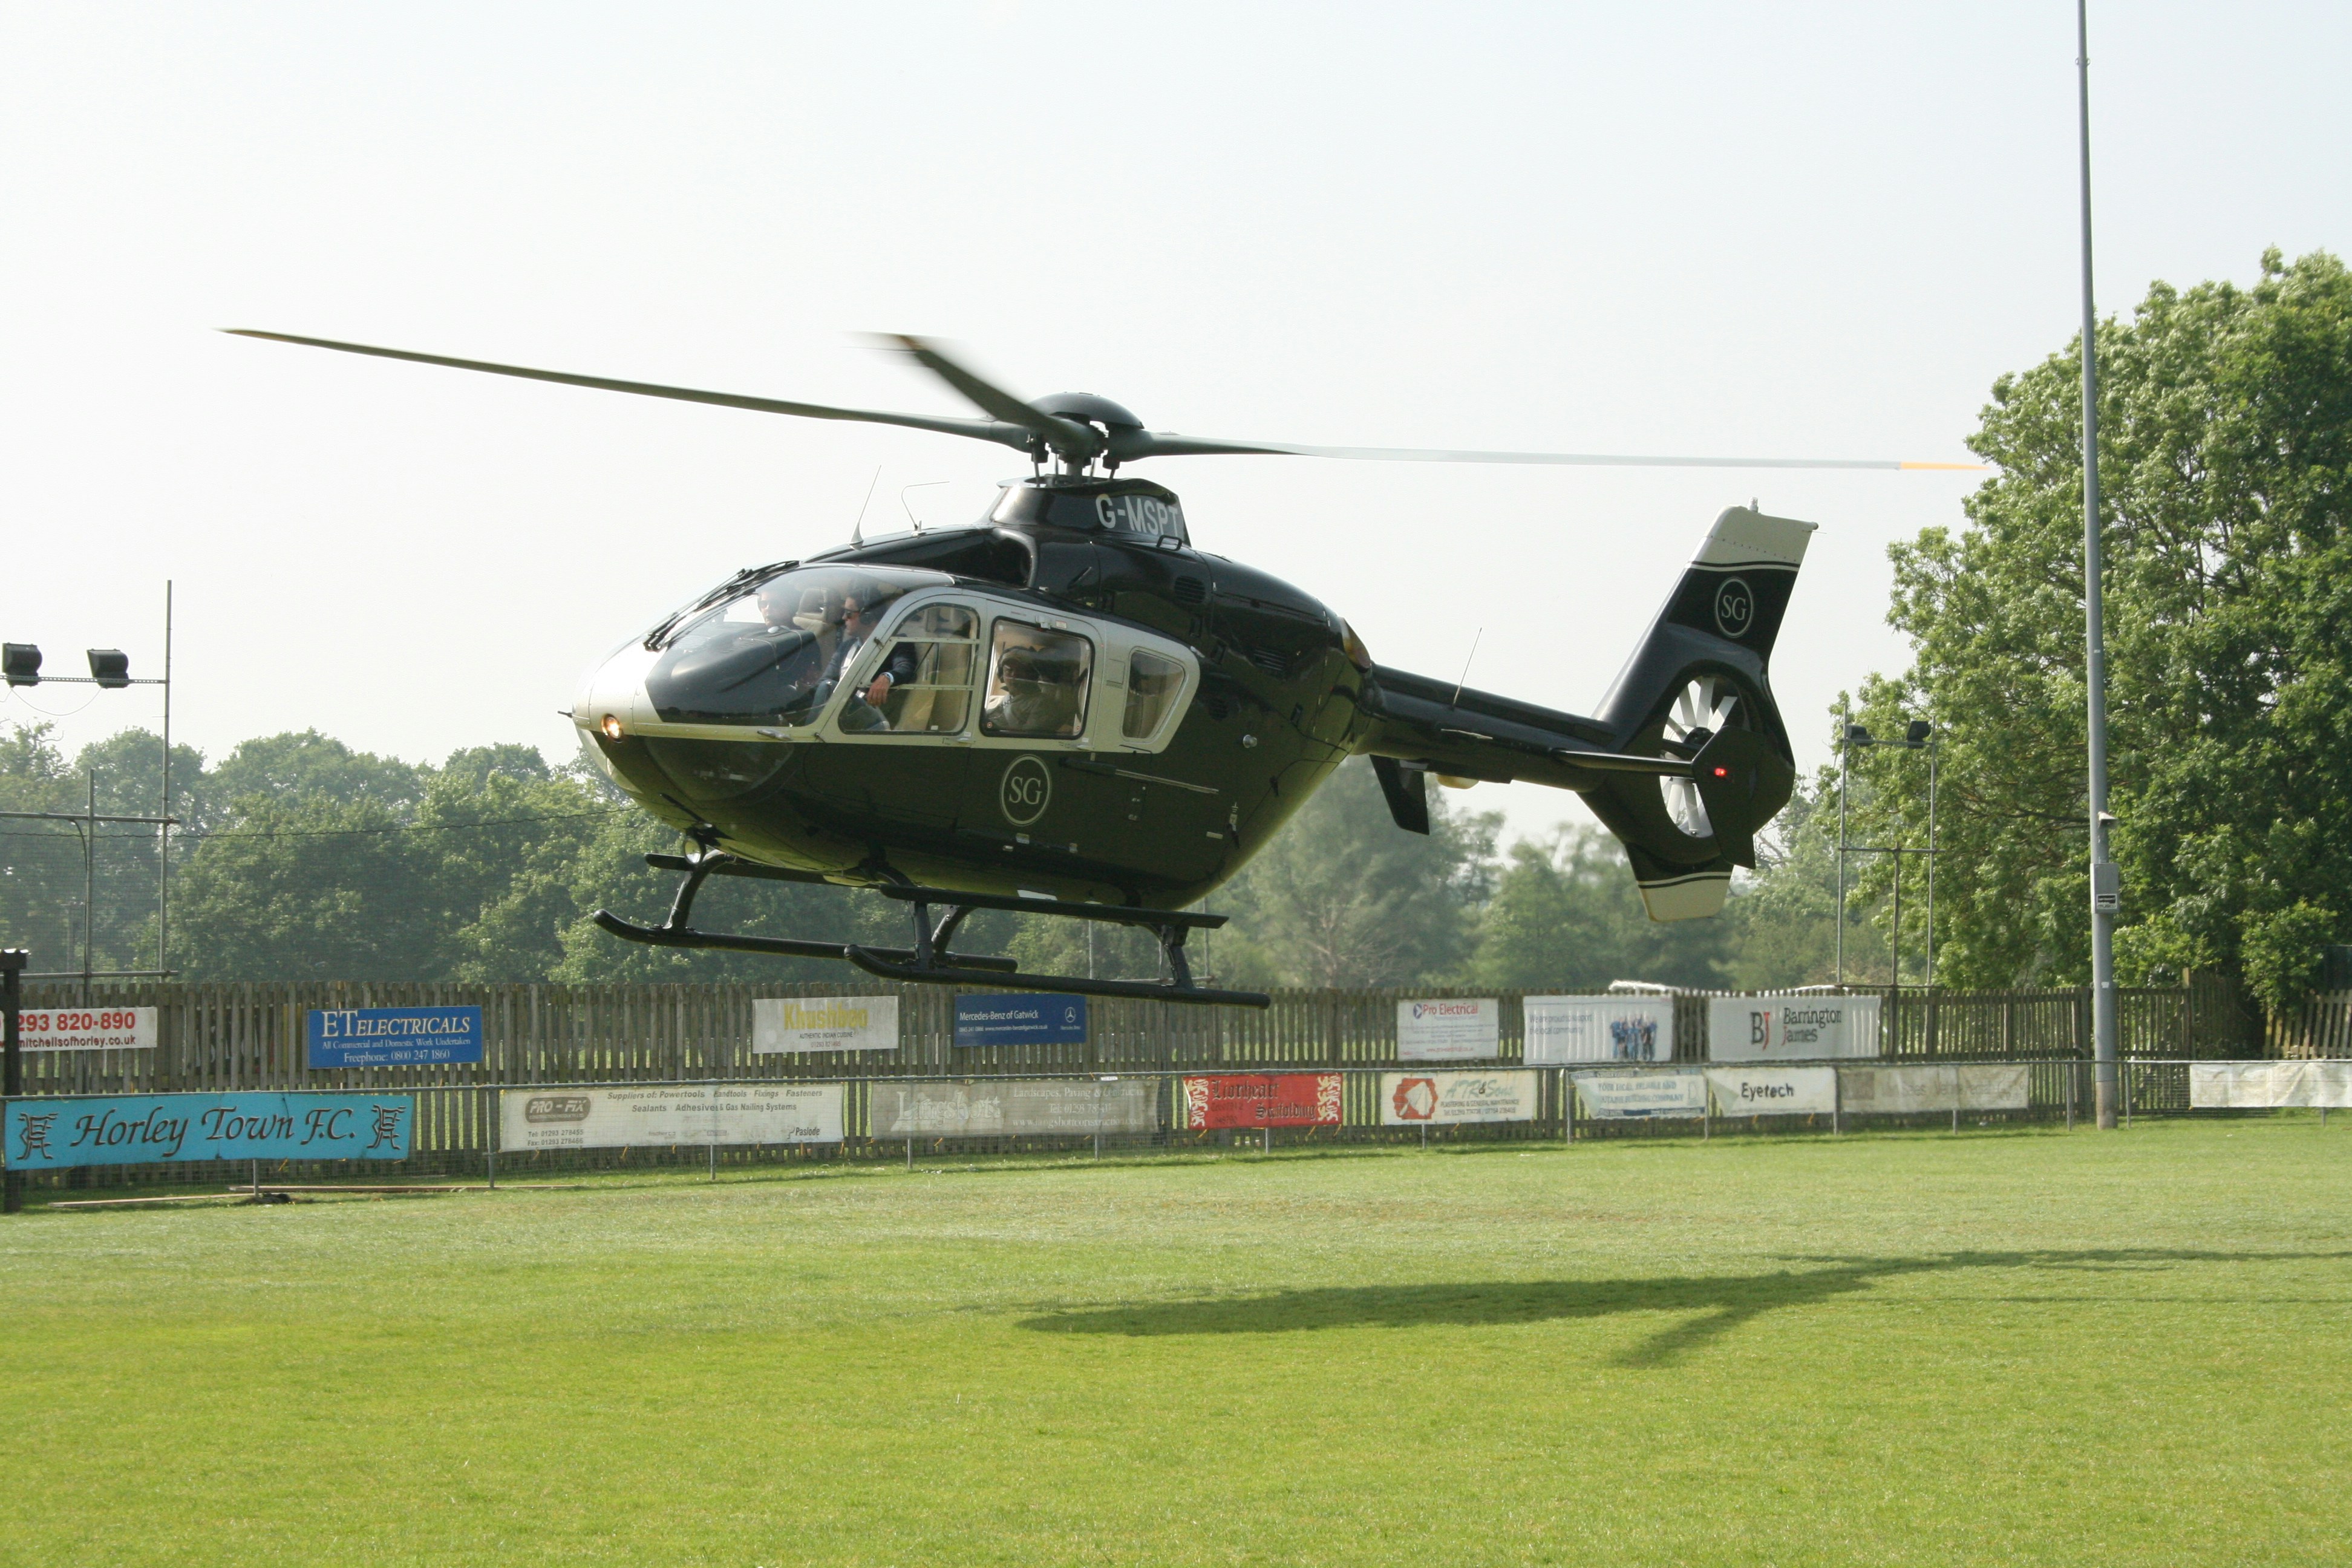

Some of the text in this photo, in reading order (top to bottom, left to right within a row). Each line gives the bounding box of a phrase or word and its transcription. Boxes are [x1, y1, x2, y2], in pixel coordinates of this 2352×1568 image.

[1096, 493, 1179, 537] G-MSPT
[1721, 595, 1746, 620] SG
[1009, 776, 1042, 805] SG
[783, 1001, 869, 1030] Khushboo
[959, 1009, 1039, 1021] Mercedes-Benz of Gatwick
[1423, 1003, 1478, 1016] Pro Electrical
[1783, 1005, 1842, 1028] Barrington
[19, 1011, 136, 1032] 293 820-890
[356, 1016, 471, 1036] ELECTRICALS
[1750, 1011, 1771, 1051] BJ
[19, 1035, 136, 1048] mitchellsofhorley.co.uk
[333, 1040, 370, 1049] Commercial
[372, 1039, 383, 1048] and
[385, 1039, 414, 1048] Domestic
[416, 1037, 433, 1047] Work
[435, 1036, 471, 1046] Undertaken
[344, 1049, 450, 1065] Freephone: 0800 247 1860
[607, 1092, 644, 1101] Suppliers
[659, 1090, 705, 1099] Powertools
[754, 1089, 779, 1099] Fixings
[1013, 1087, 1061, 1100] Landscapes,
[1064, 1087, 1090, 1100] Paving
[1094, 1088, 1100, 1097] &
[1478, 1081, 1487, 1094] &
[1741, 1082, 1795, 1102] Eyetech
[740, 1103, 764, 1112] Nailing
[765, 1103, 797, 1112] Systems
[1048, 1103, 1062, 1113] Tel:
[1064, 1102, 1085, 1114] 01293
[1255, 1102, 1317, 1121] Scaffolding
[70, 1106, 189, 1157] Horley
[201, 1105, 295, 1140] Town
[300, 1108, 356, 1145] F.C.
[795, 1126, 820, 1136] Paslode
